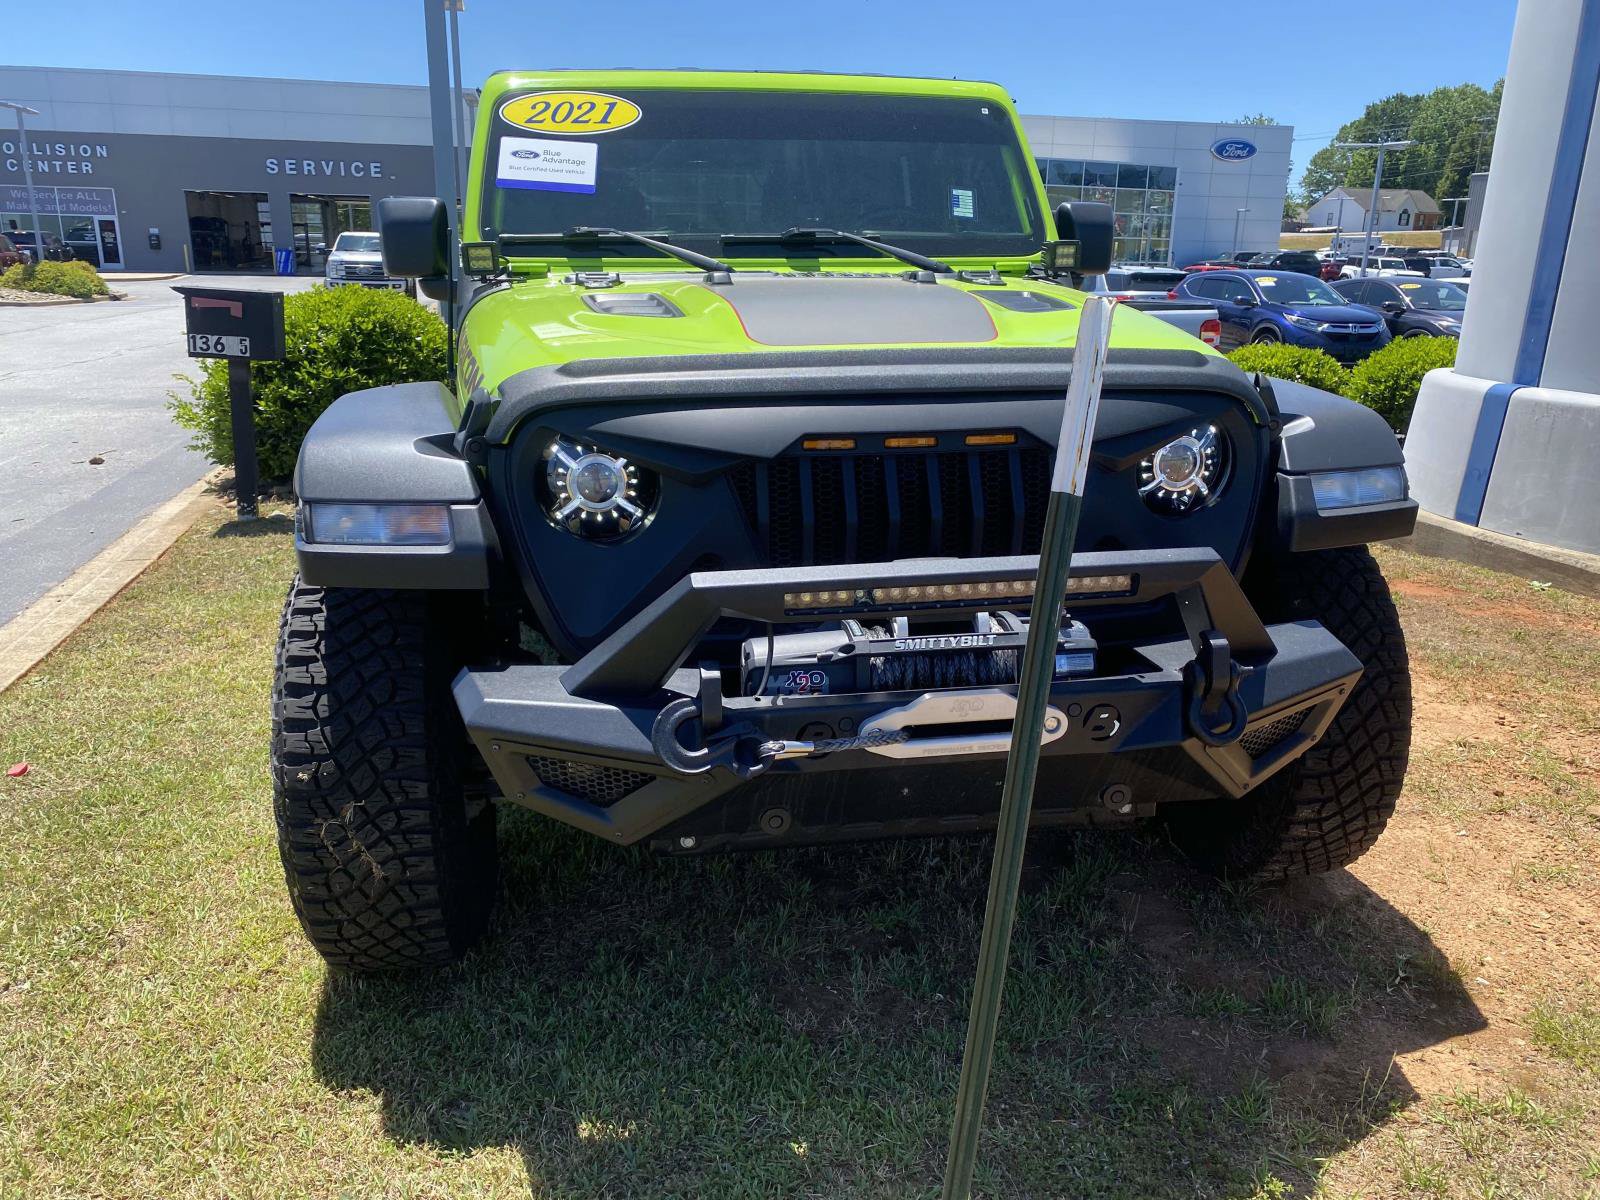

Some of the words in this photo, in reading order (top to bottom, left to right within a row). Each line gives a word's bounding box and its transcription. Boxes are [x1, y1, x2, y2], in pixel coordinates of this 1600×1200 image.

[524, 101, 618, 125] 2021
[543, 149, 562, 158] Blue
[1222, 143, 1250, 157] Ford
[6, 158, 93, 174] CENTER
[265, 158, 383, 178] SERVICE
[542, 157, 586, 168] Advantage
[10, 189, 28, 198] We
[76, 192, 101, 201] ALL
[6, 200, 41, 211] Maks
[44, 203, 66, 211] and
[894, 634, 997, 651] SMITTYBILT
